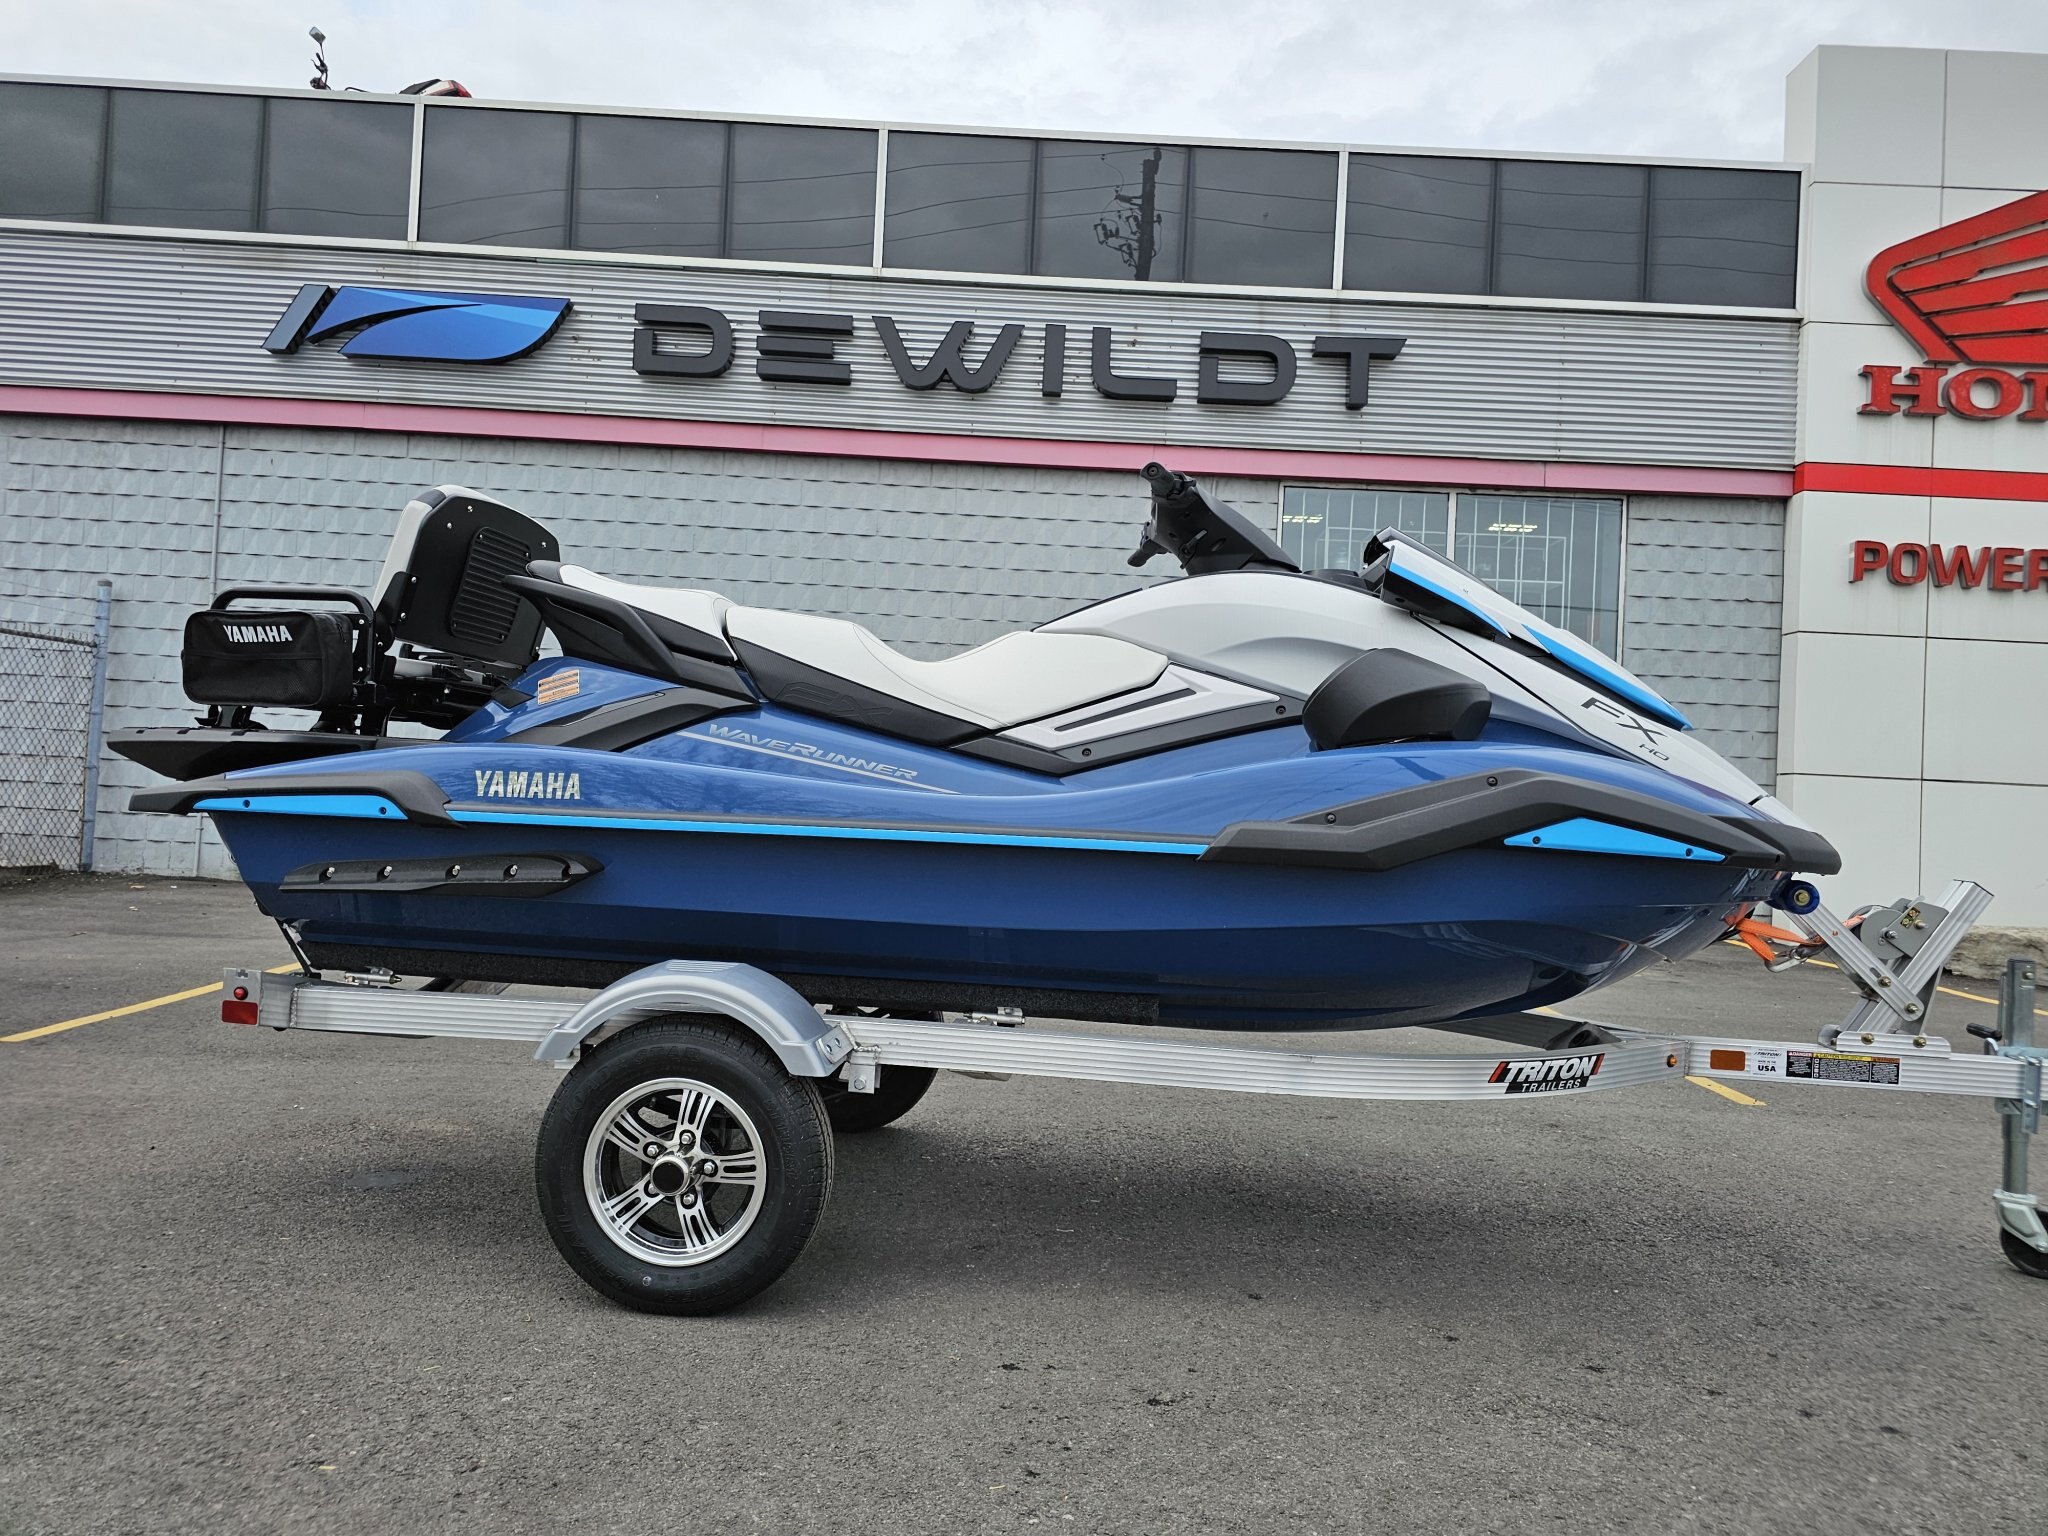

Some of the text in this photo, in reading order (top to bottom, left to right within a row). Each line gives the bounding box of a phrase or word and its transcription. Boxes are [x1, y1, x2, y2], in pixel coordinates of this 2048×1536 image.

[632, 303, 1408, 410] DEWILDT
[223, 625, 293, 642] YAMAHA
[1580, 697, 1668, 746] FX
[1638, 743, 1670, 762] HO
[475, 770, 581, 800] YAMAHA
[1504, 1055, 1598, 1083] TRITON
[1521, 1078, 1581, 1093] TRAILERS
